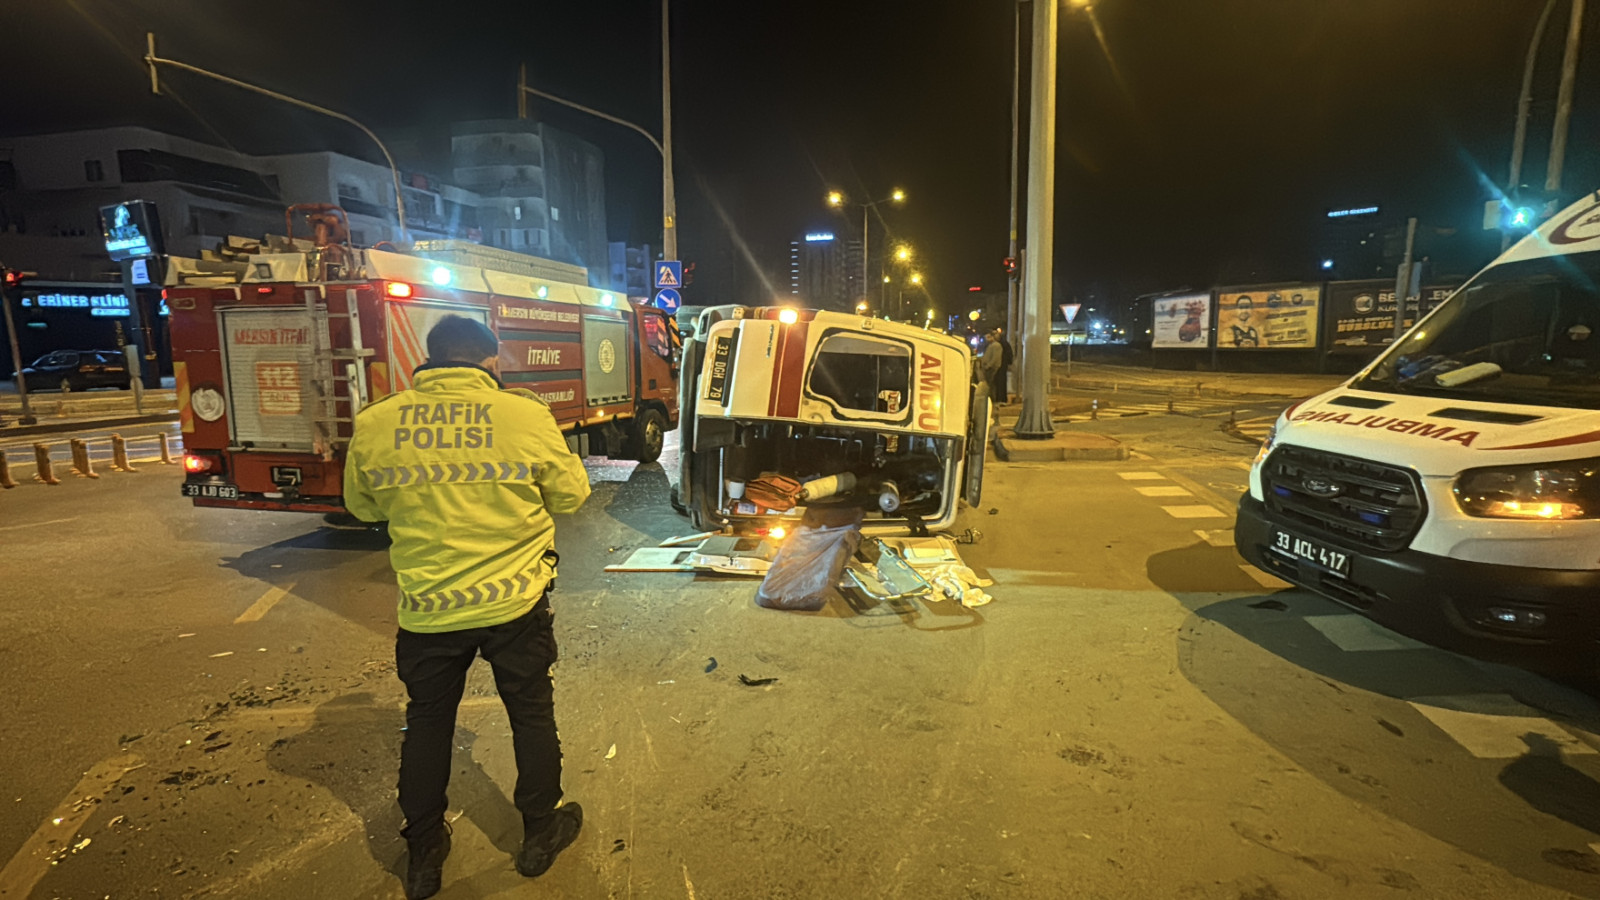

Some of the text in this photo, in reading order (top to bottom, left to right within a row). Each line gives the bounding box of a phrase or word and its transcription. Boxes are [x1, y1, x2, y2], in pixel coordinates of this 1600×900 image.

[527, 346, 561, 365] İTFAİYE
[710, 343, 729, 398] 33 DGH 79
[918, 352, 942, 431] AMBU
[187, 485, 199, 496] 33
[219, 487, 235, 498] 603
[1276, 531, 1346, 570] 33 ACL 417
